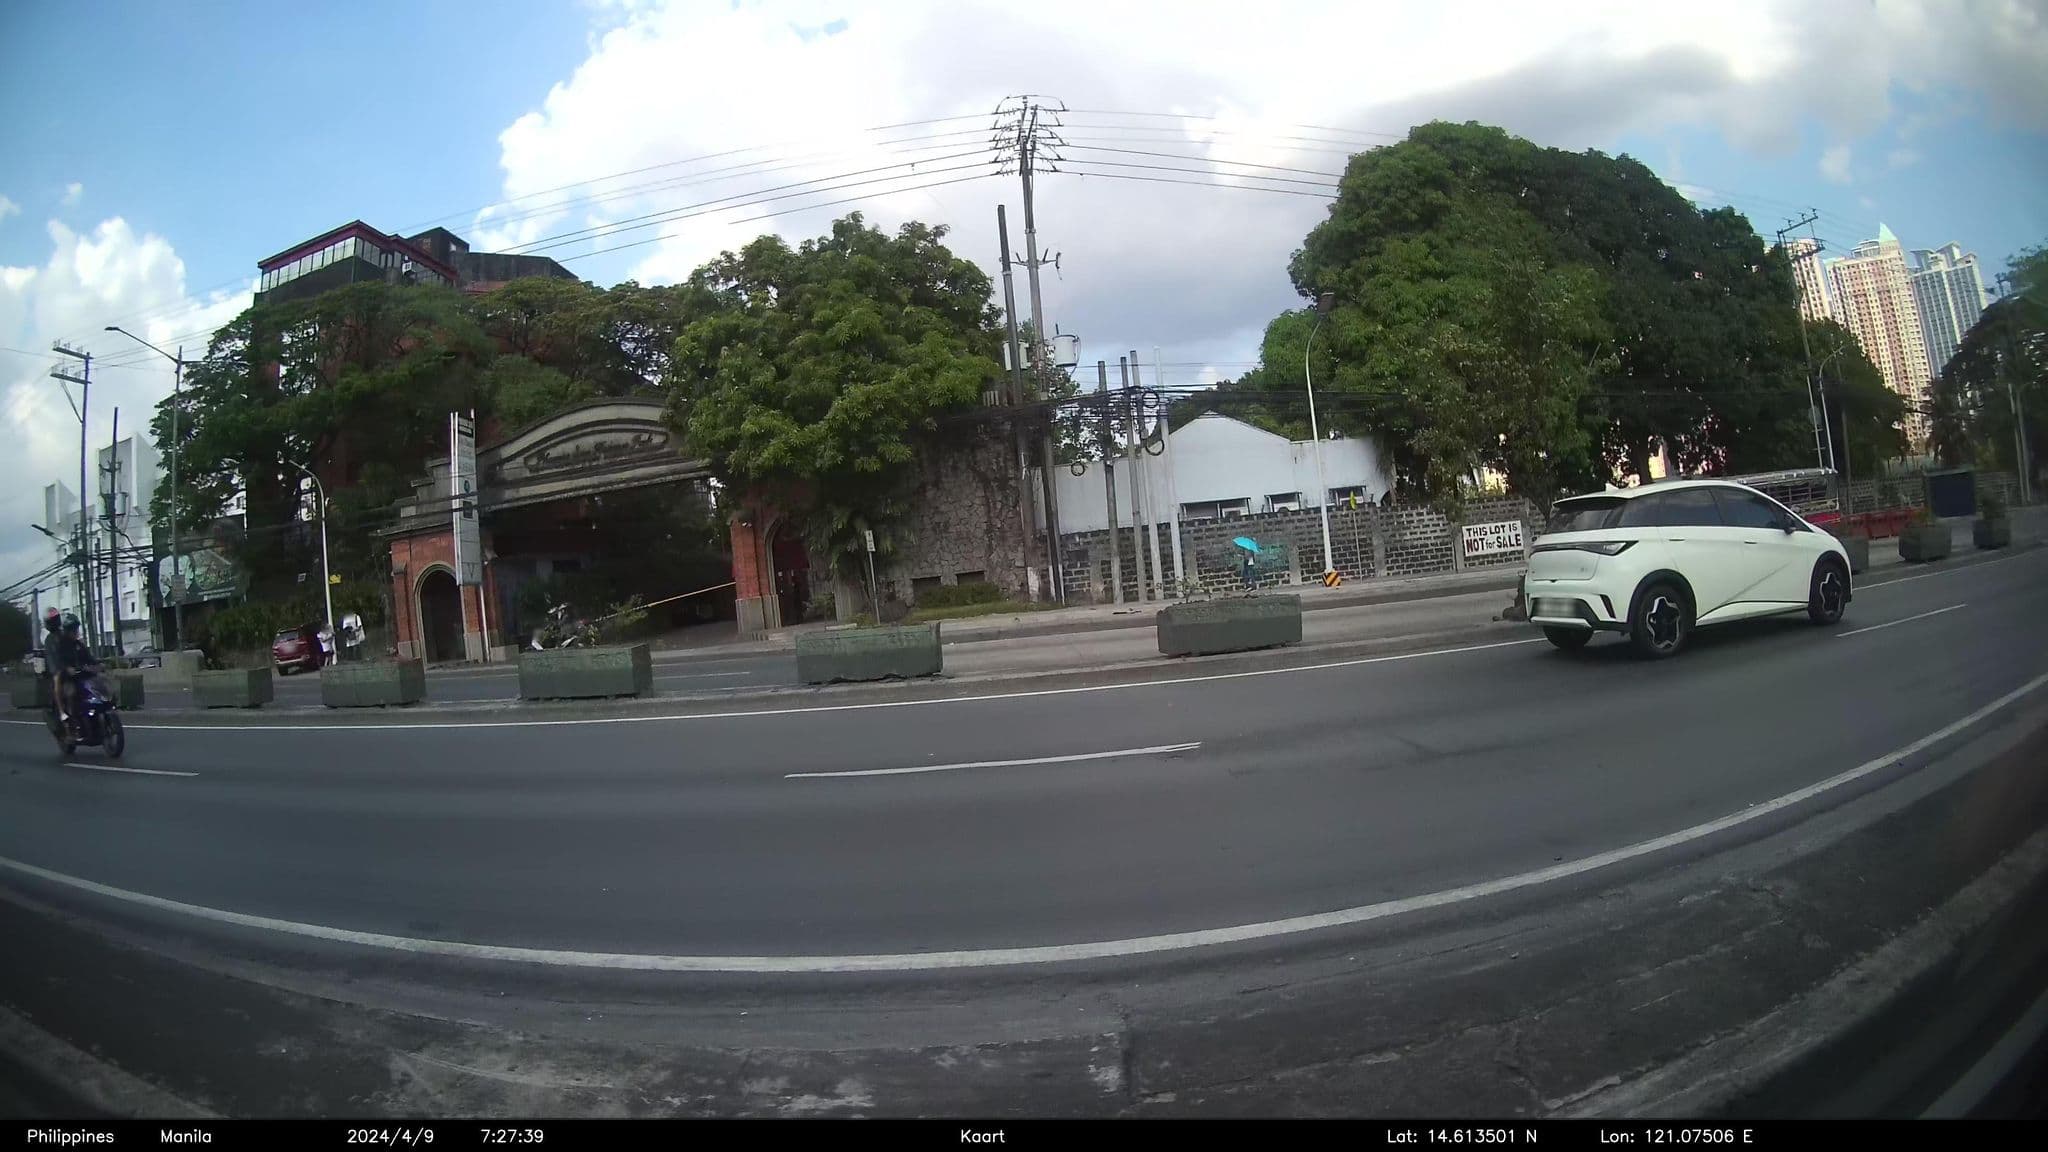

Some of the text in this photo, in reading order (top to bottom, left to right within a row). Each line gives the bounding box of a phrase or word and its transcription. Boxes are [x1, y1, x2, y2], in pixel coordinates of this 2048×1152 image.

[1466, 523, 1517, 537] THIS LOT IS
[1466, 534, 1521, 552] NOT for SALE
